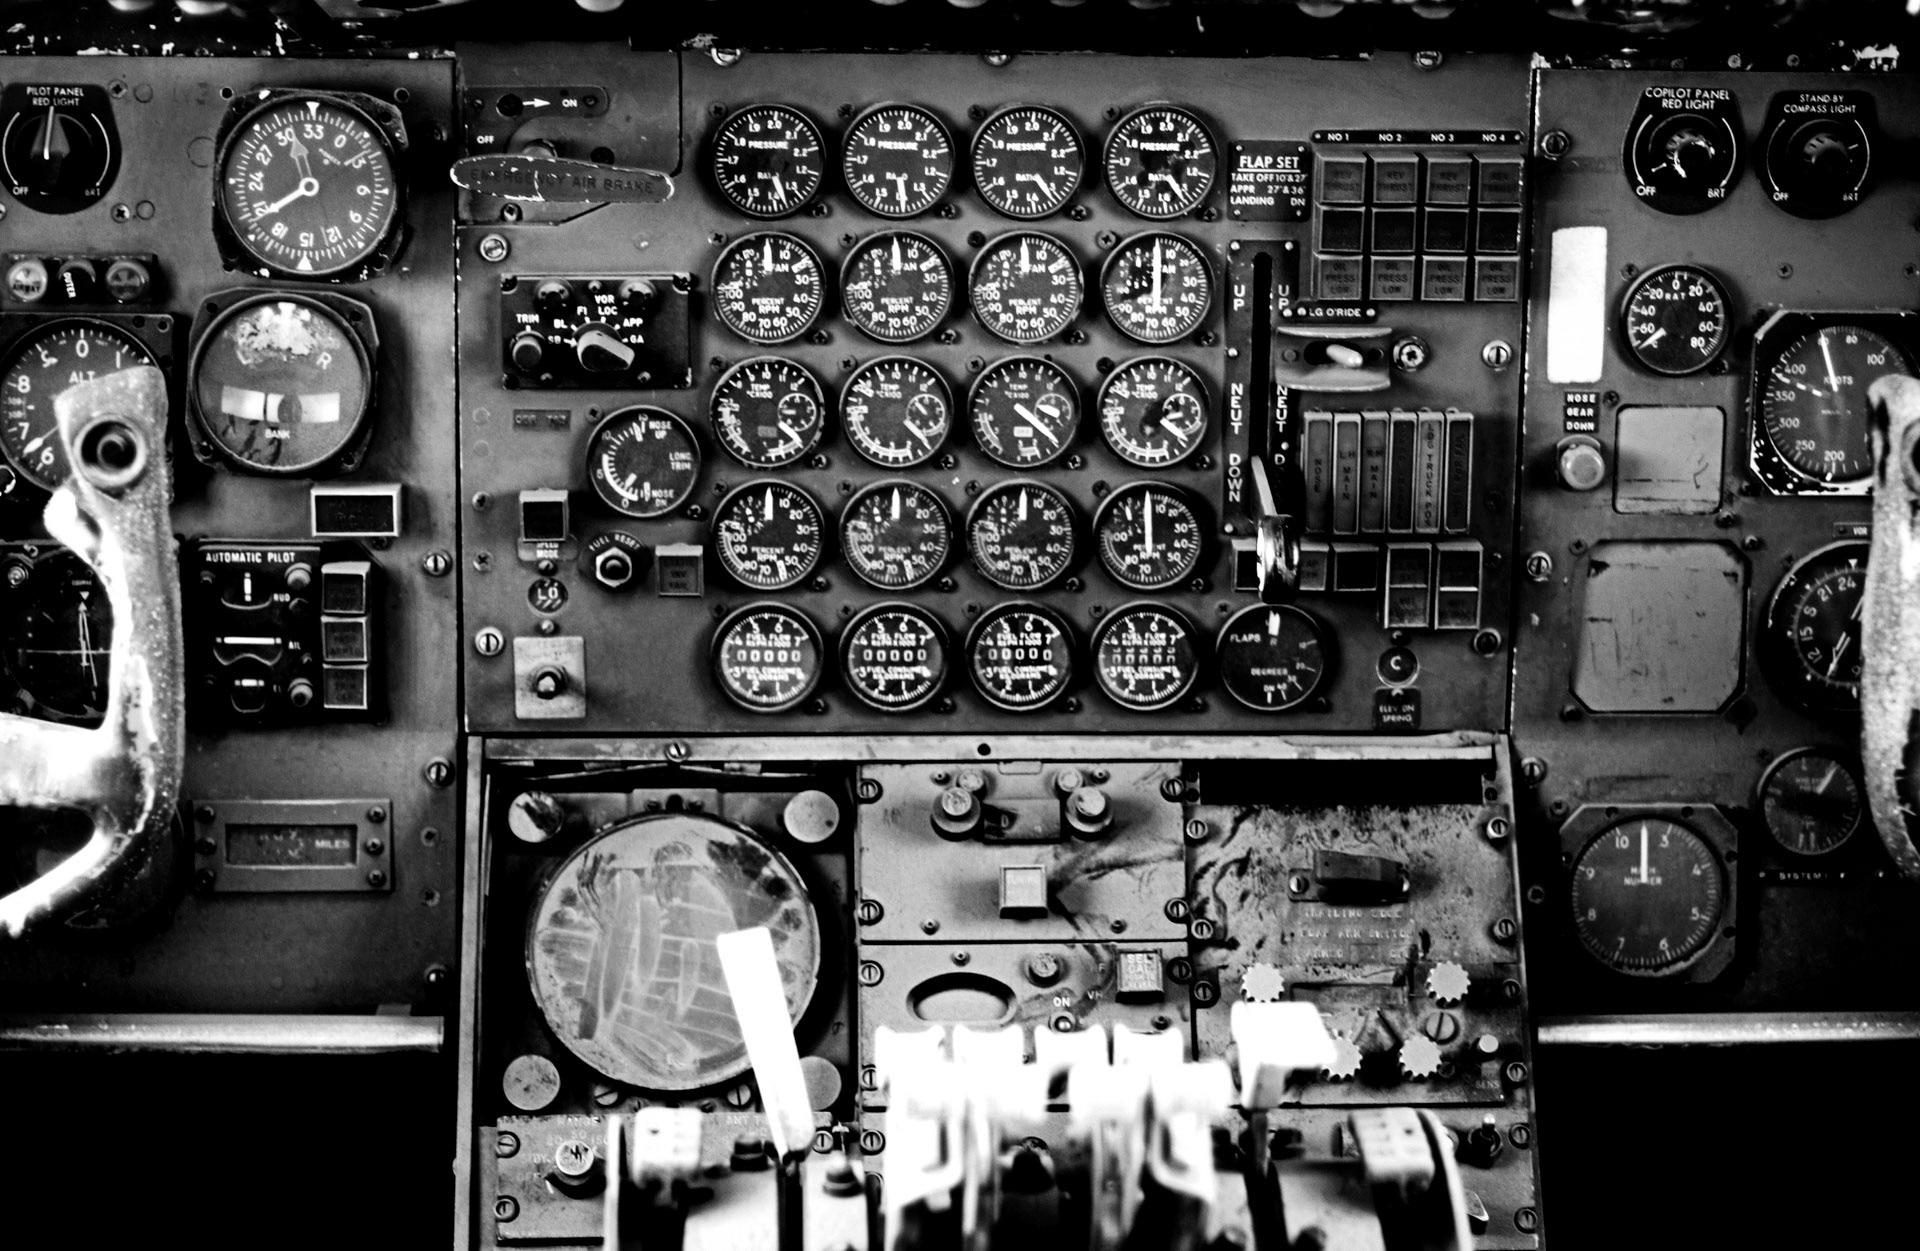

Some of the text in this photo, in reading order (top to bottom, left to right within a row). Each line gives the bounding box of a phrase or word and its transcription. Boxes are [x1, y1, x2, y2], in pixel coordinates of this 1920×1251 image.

[26, 86, 84, 96] PILOT PANEL
[1645, 87, 1730, 100] COPILOT PANEL
[32, 98, 80, 106] RED LIGHT
[562, 99, 577, 107] ON
[1662, 99, 1715, 110] RED LIGHT
[1784, 104, 1856, 113] COMPASS LIGHT
[304, 124, 323, 140] 33
[334, 133, 346, 148] 0
[476, 136, 494, 144] OFF
[748, 141, 789, 149] PRESSURE
[256, 145, 274, 165] 27
[1240, 155, 1299, 168] FLAP SET
[249, 171, 265, 191] 24
[470, 169, 654, 193] EMERGENCY AIR BRAKE
[1231, 173, 1254, 182] TAKE
[1256, 173, 1274, 182] OFF
[13, 187, 28, 195] OFF
[356, 185, 370, 196] 6
[1230, 185, 1255, 193] APPR
[1636, 186, 1656, 197] OFF
[1707, 188, 1725, 199] BRT
[1230, 196, 1305, 206] LANDING DN
[1773, 192, 1789, 201] OFF
[272, 222, 288, 239] 18
[326, 225, 343, 242] 12
[299, 232, 314, 247] 15
[63, 272, 76, 298] OUTER
[1672, 279, 1680, 290] 0
[1650, 288, 1663, 300] 20
[1689, 285, 1703, 297] 20
[595, 295, 615, 304] VOR
[1233, 284, 1245, 311] UP
[1278, 284, 1290, 310] UP
[598, 307, 617, 315] LOC
[759, 305, 780, 314] RPM
[888, 304, 909, 313] RPM
[1016, 306, 1037, 315] RPM
[1309, 308, 1361, 317] LG O'RIDE
[1640, 305, 1656, 316] 40
[1699, 302, 1713, 313] 40
[516, 314, 539, 323] TRIM
[554, 319, 568, 328] BL
[623, 318, 643, 327] APP
[1640, 323, 1655, 334] 60
[1699, 321, 1714, 332] 60
[1691, 336, 1705, 348] 80
[1846, 334, 1858, 344] 80
[76, 340, 89, 358] 0
[316, 352, 332, 369] R
[1867, 354, 1885, 365] 100
[1784, 364, 1806, 374] 400
[69, 371, 95, 383] ALT
[18, 375, 30, 393] 8
[1567, 394, 1596, 403] NOSE
[1775, 391, 1795, 401] 350
[1231, 383, 1244, 434] NEUT
[1276, 385, 1288, 432] NEUT
[1567, 408, 1594, 417] GEAR
[649, 421, 671, 429] NOSE
[1566, 422, 1594, 431] DOWN
[1779, 418, 1800, 428] 300
[18, 422, 29, 439] 7
[265, 429, 290, 439] BANK
[655, 430, 666, 439] UP
[1795, 440, 1816, 451] 250
[41, 447, 54, 464] 6
[1824, 451, 1845, 461] 200
[671, 462, 691, 470] TRIM
[1228, 453, 1243, 502] DOWN
[1370, 465, 1378, 498] MAIN
[652, 489, 674, 498] NOSE
[622, 498, 629, 508] 0
[1853, 526, 1868, 536] VOR
[615, 534, 641, 550] RESET
[206, 552, 295, 563] AUTOMATIC PILOT
[536, 550, 558, 558] MODE
[1838, 576, 1856, 591] 24
[1230, 633, 1261, 643] FLAPS
[1800, 626, 1814, 641] 15
[1382, 714, 1412, 722] SPRING
[315, 840, 350, 849] MILES
[1615, 836, 1629, 849] 10
[1660, 834, 1669, 848] 3
[1586, 867, 1595, 880] 9
[1692, 863, 1701, 876] 4
[1588, 908, 1596, 921] 8
[1690, 907, 1700, 921] 5
[1618, 937, 1625, 950] 7
[1660, 937, 1668, 950] 6
[1053, 996, 1070, 1007] ON
[1476, 1080, 1499, 1089] SENS
